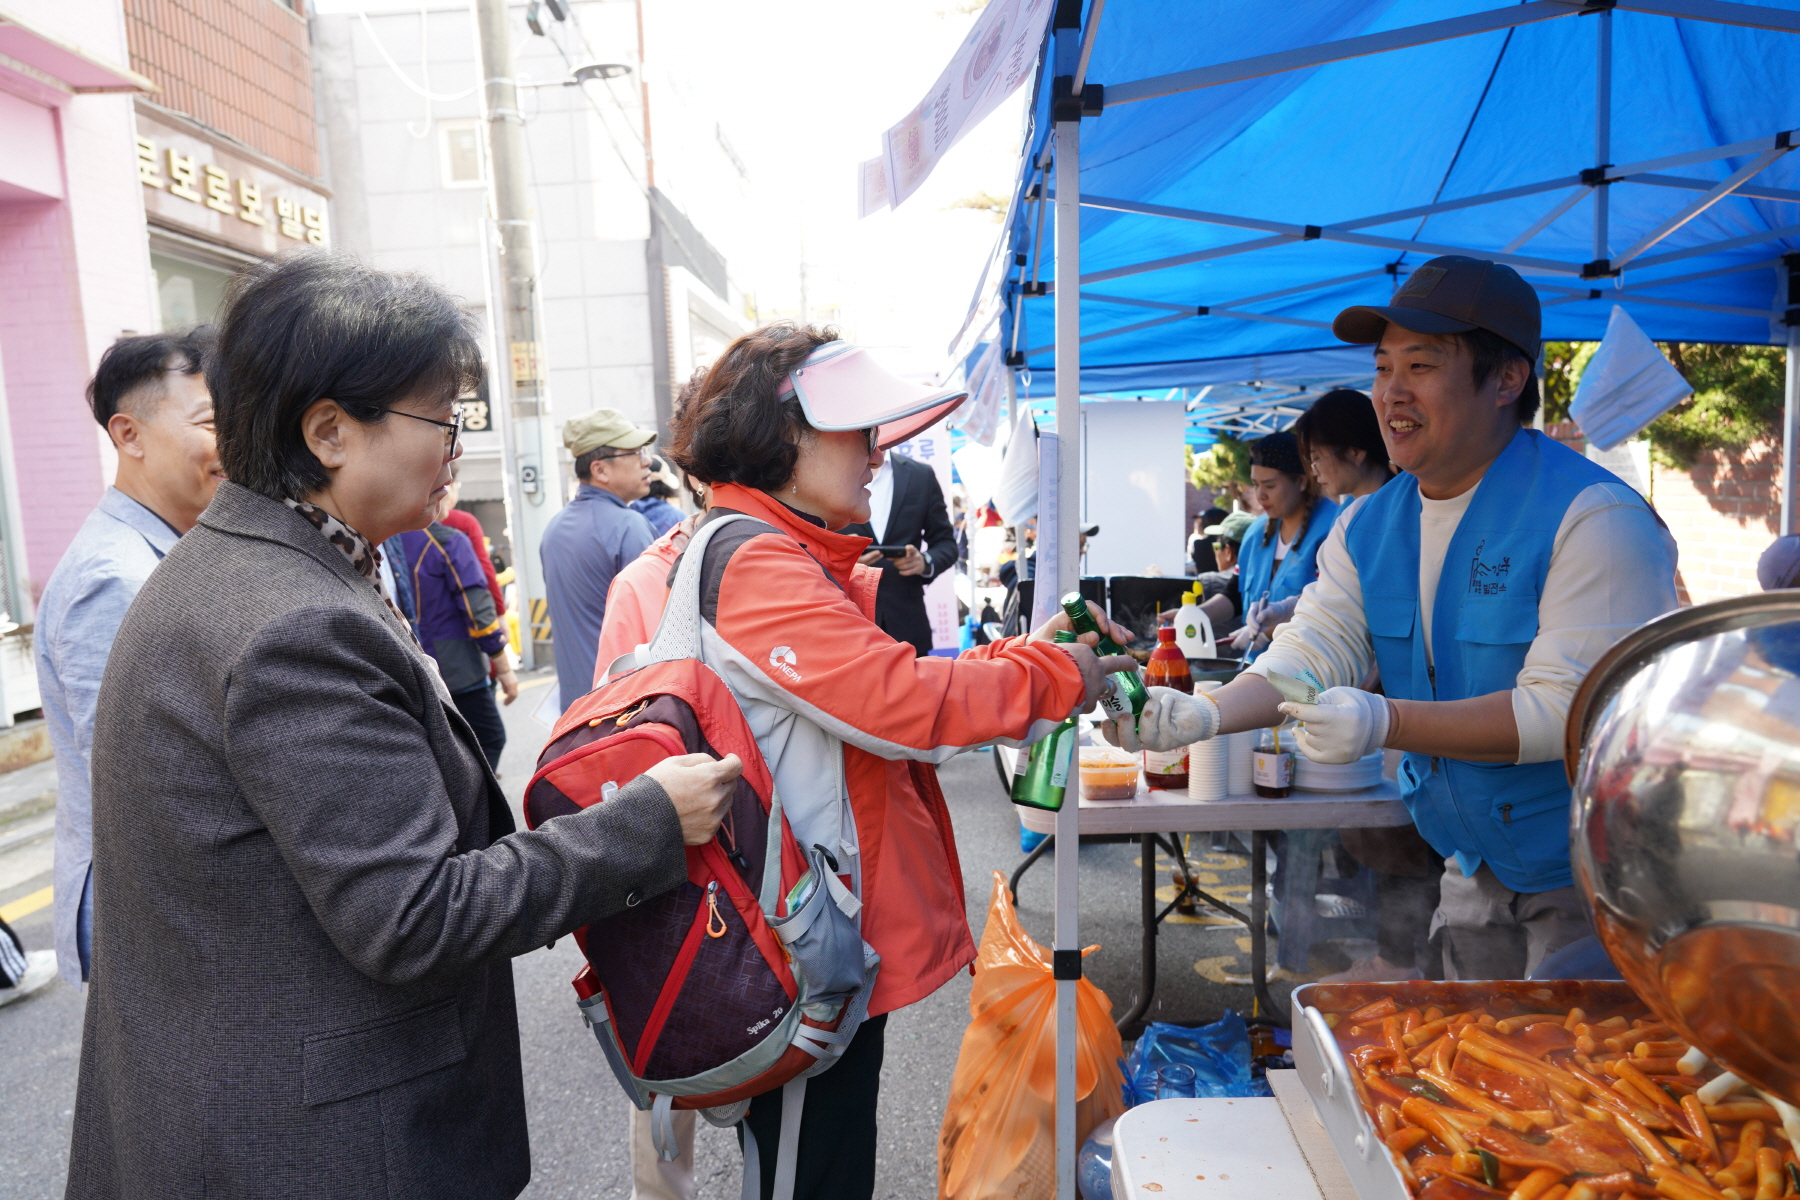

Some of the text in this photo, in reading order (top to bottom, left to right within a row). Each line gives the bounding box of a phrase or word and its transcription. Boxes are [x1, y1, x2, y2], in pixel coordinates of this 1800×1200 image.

[779, 662, 802, 683] NEPA
[747, 1006, 784, 1035] Spika 20
